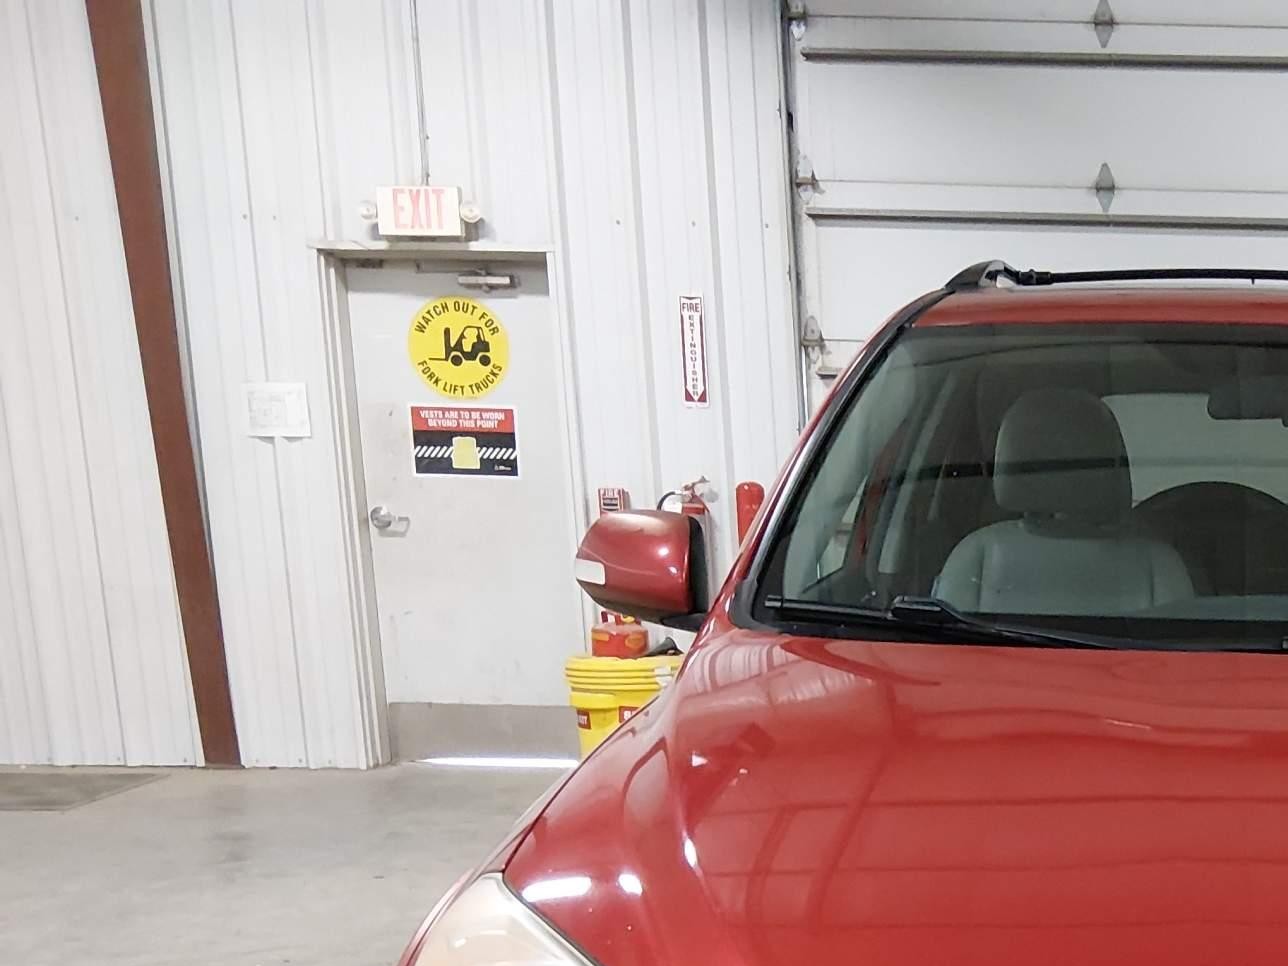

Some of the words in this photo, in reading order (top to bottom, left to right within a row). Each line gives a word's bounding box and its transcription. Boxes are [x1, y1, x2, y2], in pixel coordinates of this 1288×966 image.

[392, 188, 445, 230] EXIT
[415, 302, 449, 334] WATCH
[454, 300, 478, 316] OUT
[479, 312, 500, 336] FOR
[682, 303, 700, 313] FIRE
[688, 314, 699, 397] EXTINGUISHER
[418, 360, 442, 387] FORK
[443, 381, 465, 396] LIFT
[469, 363, 502, 395] TRUCKS
[420, 410, 443, 419] VESTS
[445, 411, 459, 419] ARE
[460, 411, 470, 419] TO
[471, 411, 481, 420] BE
[482, 412, 505, 420] WORN
[427, 418, 457, 427] BEYOND
[459, 419, 475, 428] THIS
[477, 419, 499, 429] POINT
